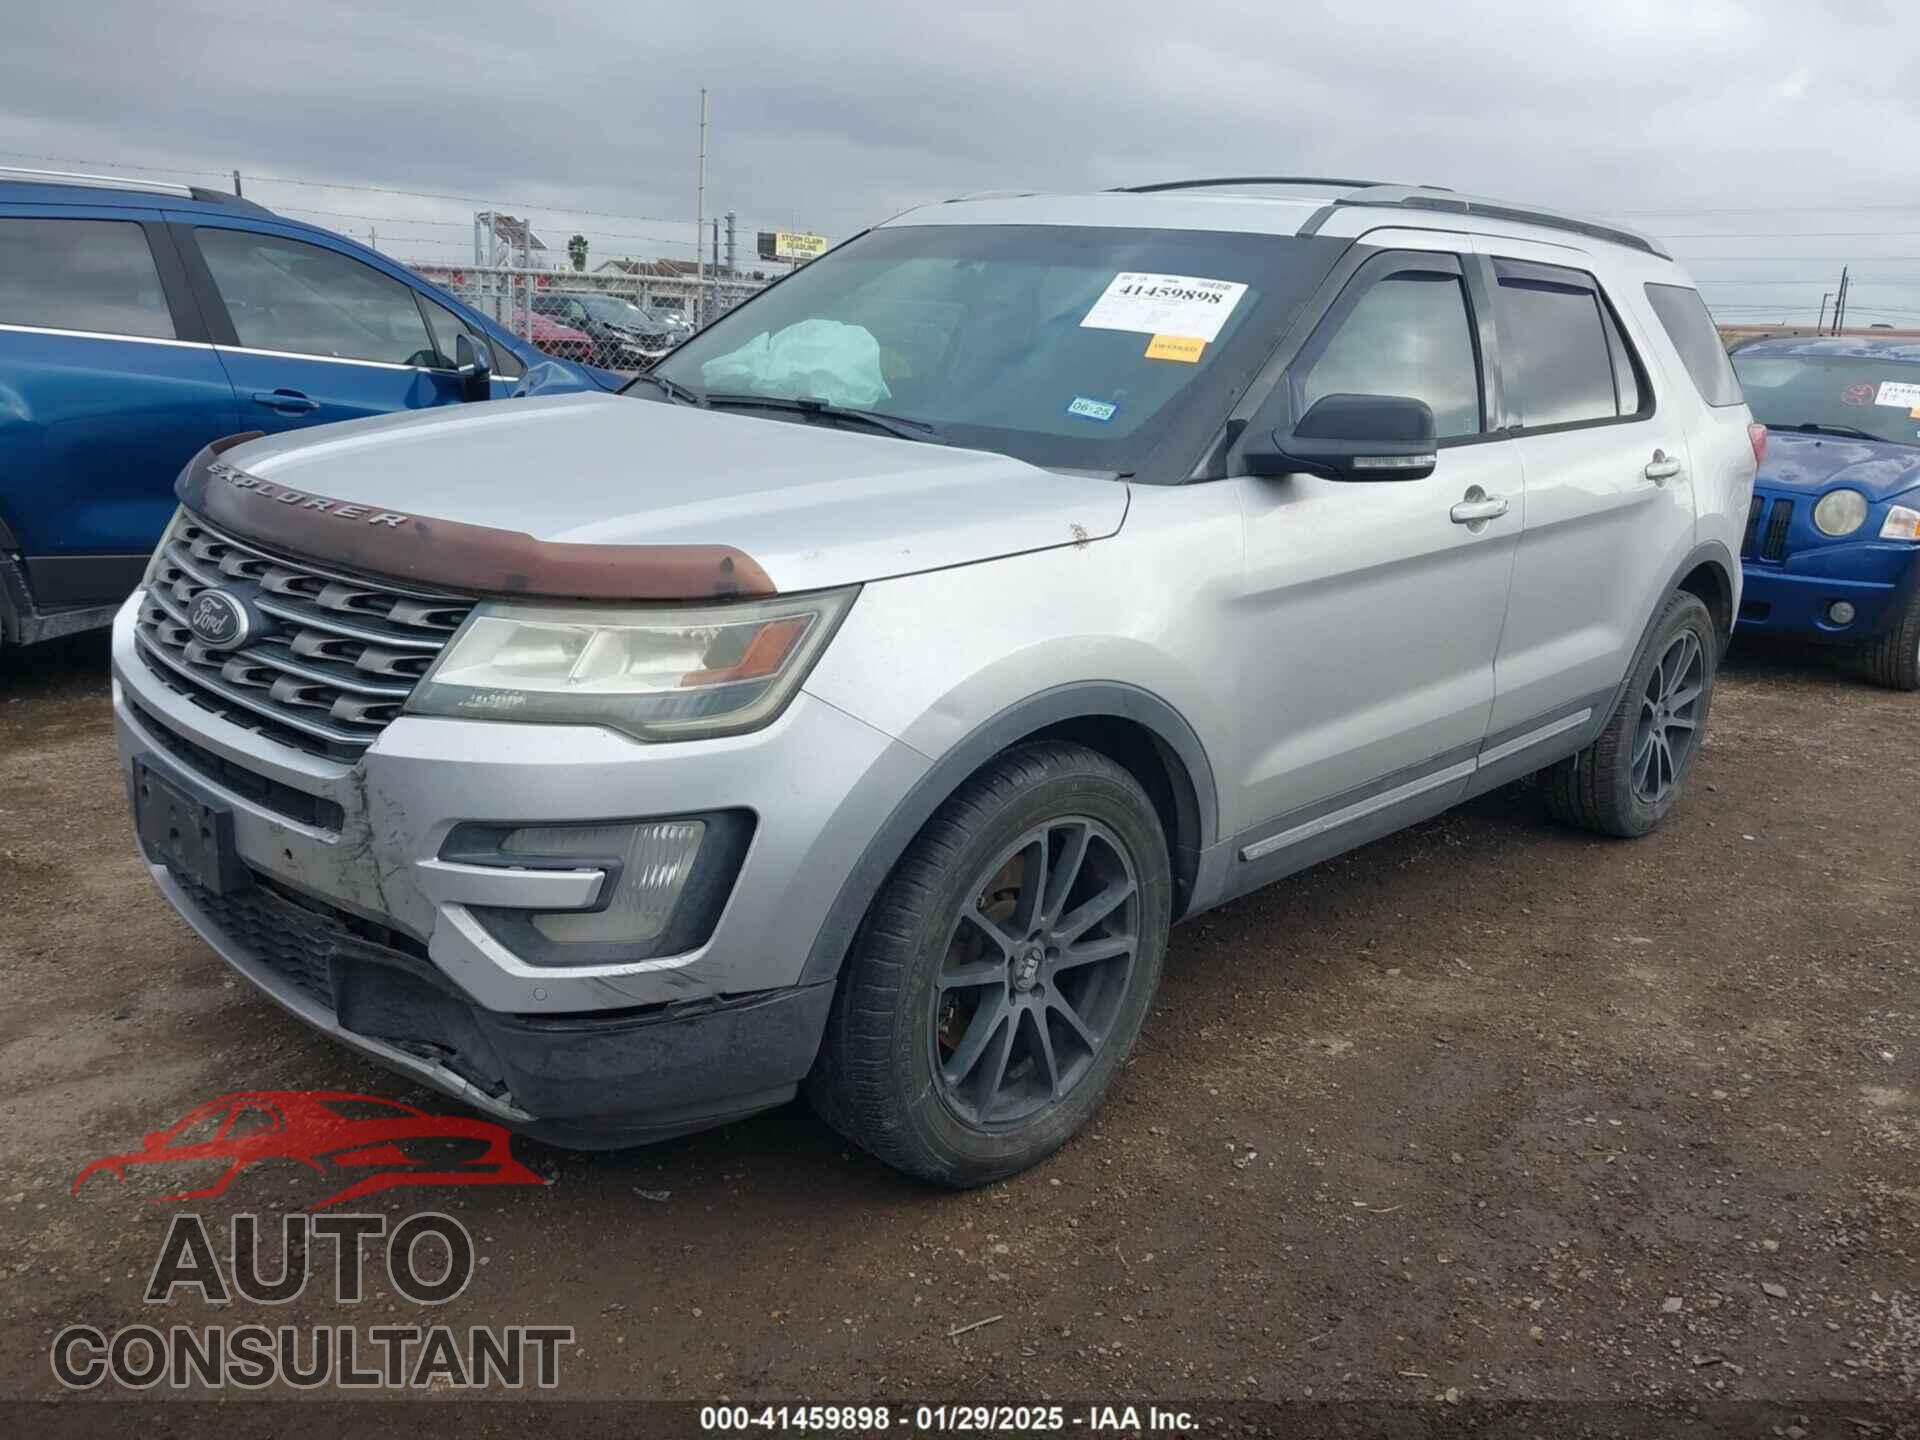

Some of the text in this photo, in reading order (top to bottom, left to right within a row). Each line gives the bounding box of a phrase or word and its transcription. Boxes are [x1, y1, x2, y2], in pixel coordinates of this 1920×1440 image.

[1119, 284, 1224, 304] 41459898
[207, 463, 409, 528] EXPLORER
[192, 599, 229, 635] Ford
